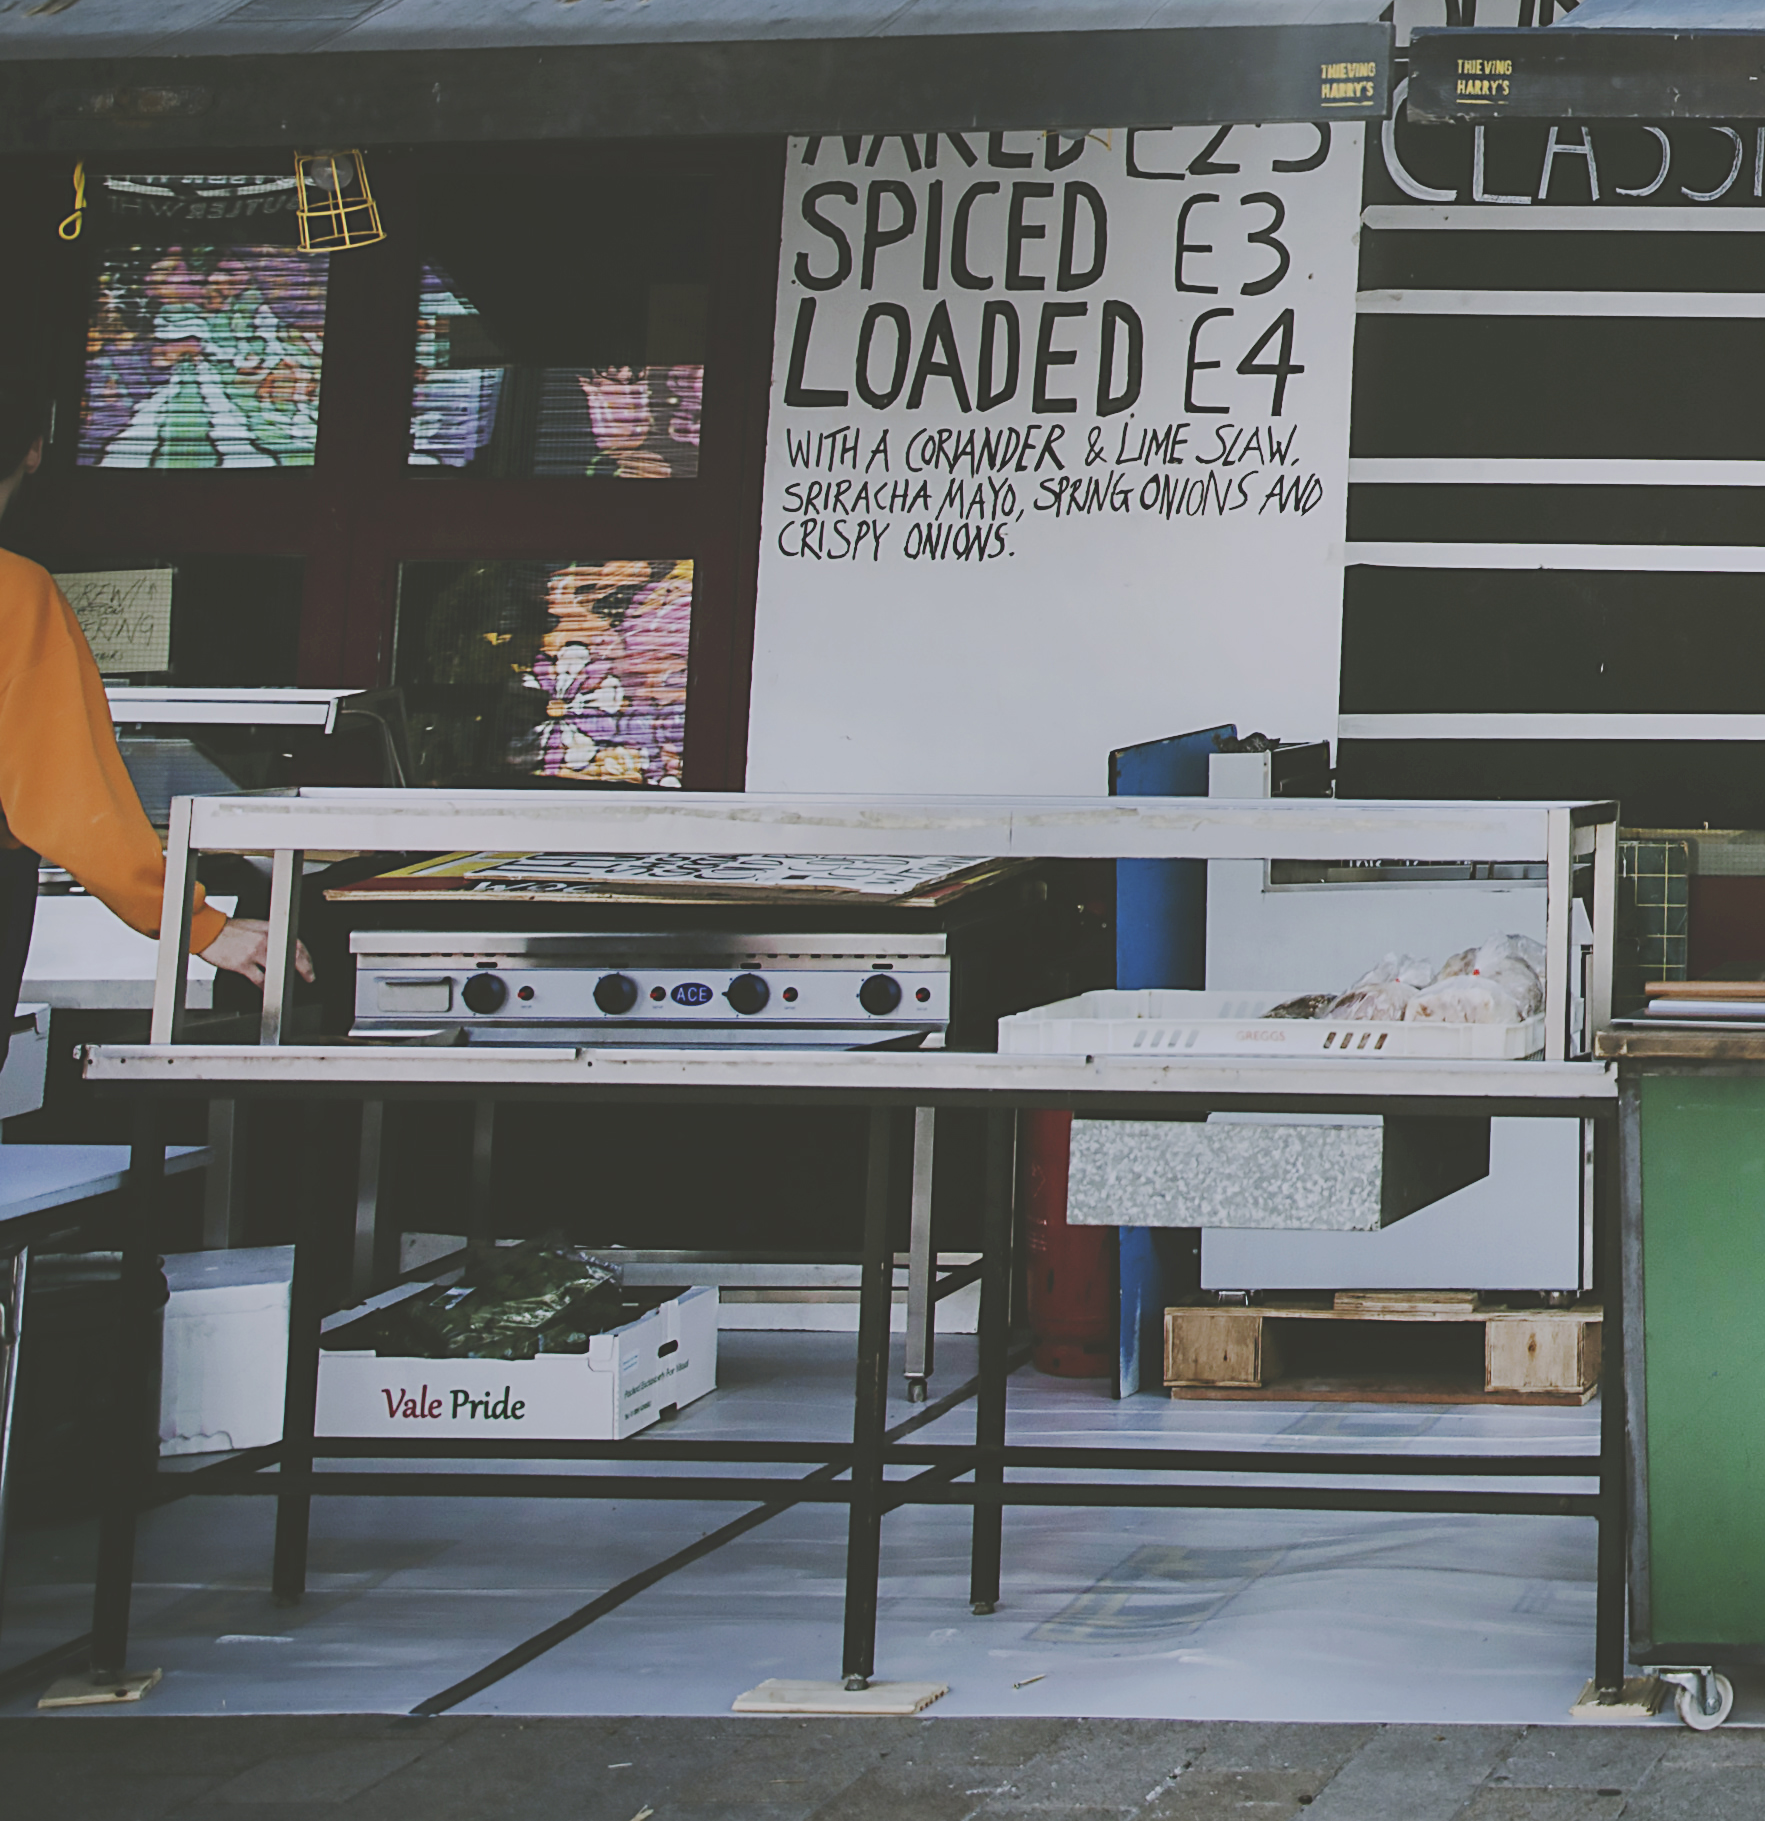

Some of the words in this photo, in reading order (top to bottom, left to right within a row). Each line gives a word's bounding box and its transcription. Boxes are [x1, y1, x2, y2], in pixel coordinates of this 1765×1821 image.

[1320, 61, 1377, 80] THIEVING
[1456, 58, 1513, 76] THIEVING
[1320, 81, 1375, 100] HARRY'S
[1456, 78, 1511, 97] HARRY'S
[793, 179, 1108, 292] SPICED
[783, 297, 1143, 417] LOADED
[786, 425, 859, 474] WITH
[868, 427, 891, 473] A
[905, 422, 1066, 478] CORIANDER
[1085, 425, 1108, 466] &
[1115, 422, 1191, 467] LIME
[782, 480, 932, 516] SRIRACHA
[1032, 470, 1135, 517] SPRING
[1139, 470, 1250, 521] ONIONS
[1258, 474, 1324, 517] AND
[777, 520, 890, 562] CRISPY
[903, 521, 1016, 562] ONIONS.
[676, 984, 708, 1003] ACE
[1236, 1030, 1286, 1042] GREGGS
[381, 1385, 443, 1421] Vale
[449, 1387, 527, 1422] Pride
